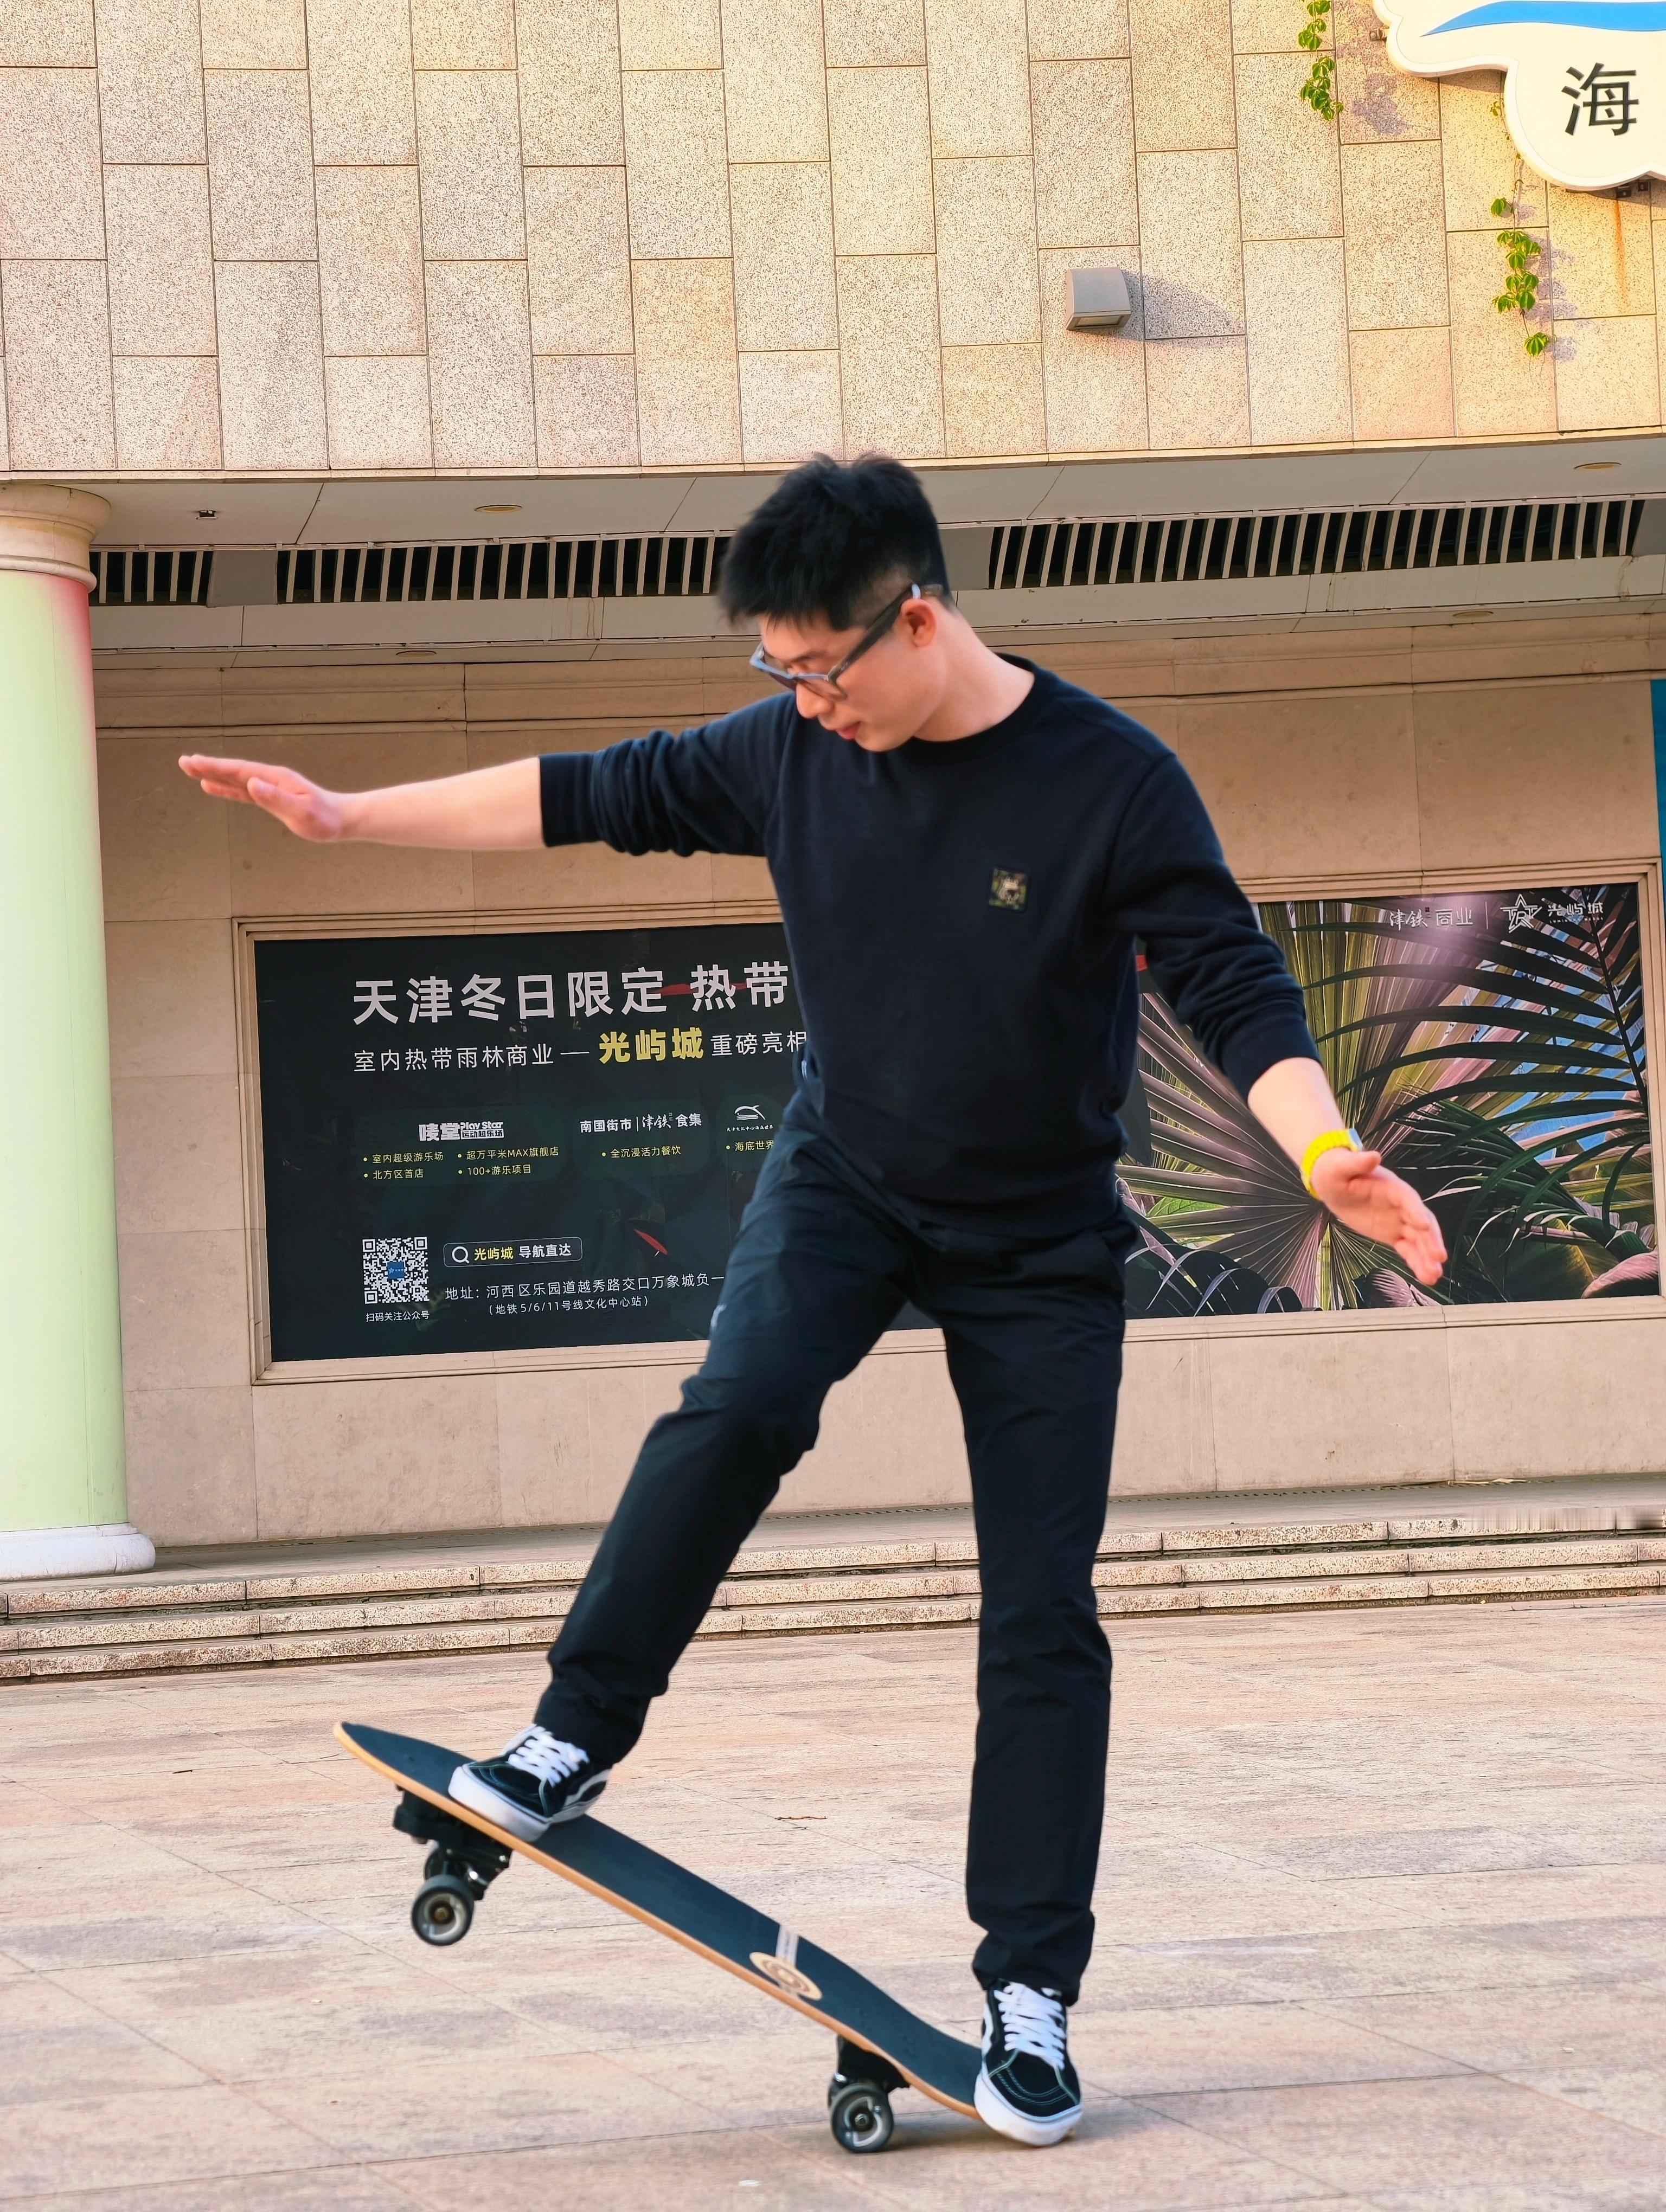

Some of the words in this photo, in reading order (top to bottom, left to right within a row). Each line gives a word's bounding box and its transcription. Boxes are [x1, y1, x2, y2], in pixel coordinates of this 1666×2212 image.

[1561, 62, 1639, 136] 海
[1435, 906, 1473, 926] 商业
[354, 967, 667, 1025] 天津冬日限定
[690, 961, 789, 1012] 热带
[354, 1043, 554, 1072] 室内热带雨林商业
[599, 1027, 704, 1064] 光屿城
[710, 1030, 807, 1057] 重磅亮相
[580, 1118, 632, 1133] 南国街市
[675, 1113, 702, 1128] 食集
[466, 1146, 559, 1160] 超万平米MAX旗舰店
[610, 1145, 681, 1158] 全沉浸活力餐饮
[734, 1140, 774, 1152] 海底世界
[372, 1151, 444, 1163] 室内超级游乐场
[373, 1168, 424, 1180] 北方区首店
[467, 1164, 531, 1176] 100+游乐项目
[473, 1246, 514, 1261] 光屿城
[518, 1243, 572, 1258] 导航直达
[366, 1310, 430, 1322] 扫码关注公众号
